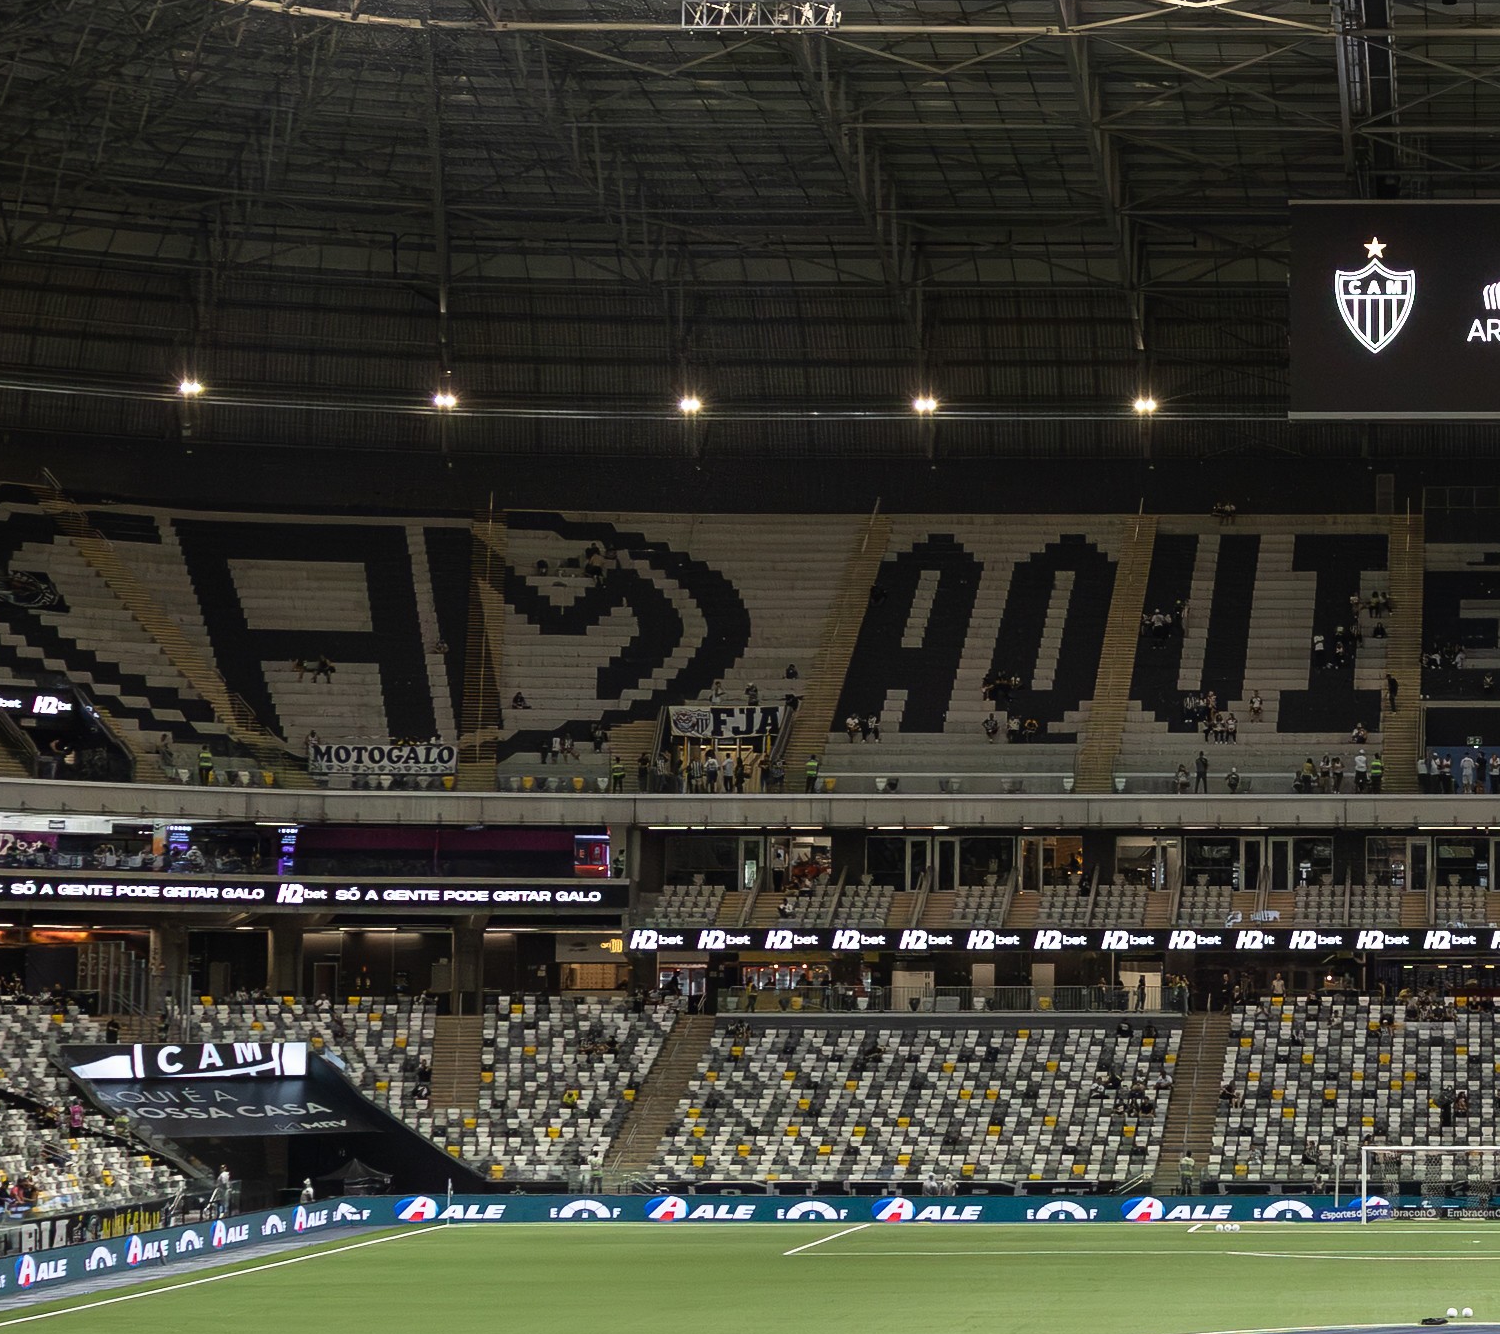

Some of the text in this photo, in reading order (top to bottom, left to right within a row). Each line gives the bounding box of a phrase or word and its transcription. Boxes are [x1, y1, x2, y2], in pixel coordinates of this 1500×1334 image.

[1348, 280, 1403, 295] CAM
[709, 706, 780, 737] FJA
[311, 745, 455, 765] MOTOGALO
[10, 880, 36, 896] SÓ
[39, 883, 54, 896] A
[57, 884, 113, 897] GENTE
[116, 885, 160, 898] PODE
[163, 886, 219, 899] GRITAR
[222, 887, 265, 900] GALO
[335, 885, 361, 901] SÓ
[365, 889, 379, 901] A
[383, 889, 440, 901] GENTE
[443, 890, 489, 902] PODE
[493, 890, 551, 902] GRITAR
[555, 890, 602, 902] GALO
[156, 1042, 263, 1074] CAM
[183, 1087, 208, 1104] É
[215, 1089, 240, 1103] A
[236, 1101, 333, 1119] CASA
